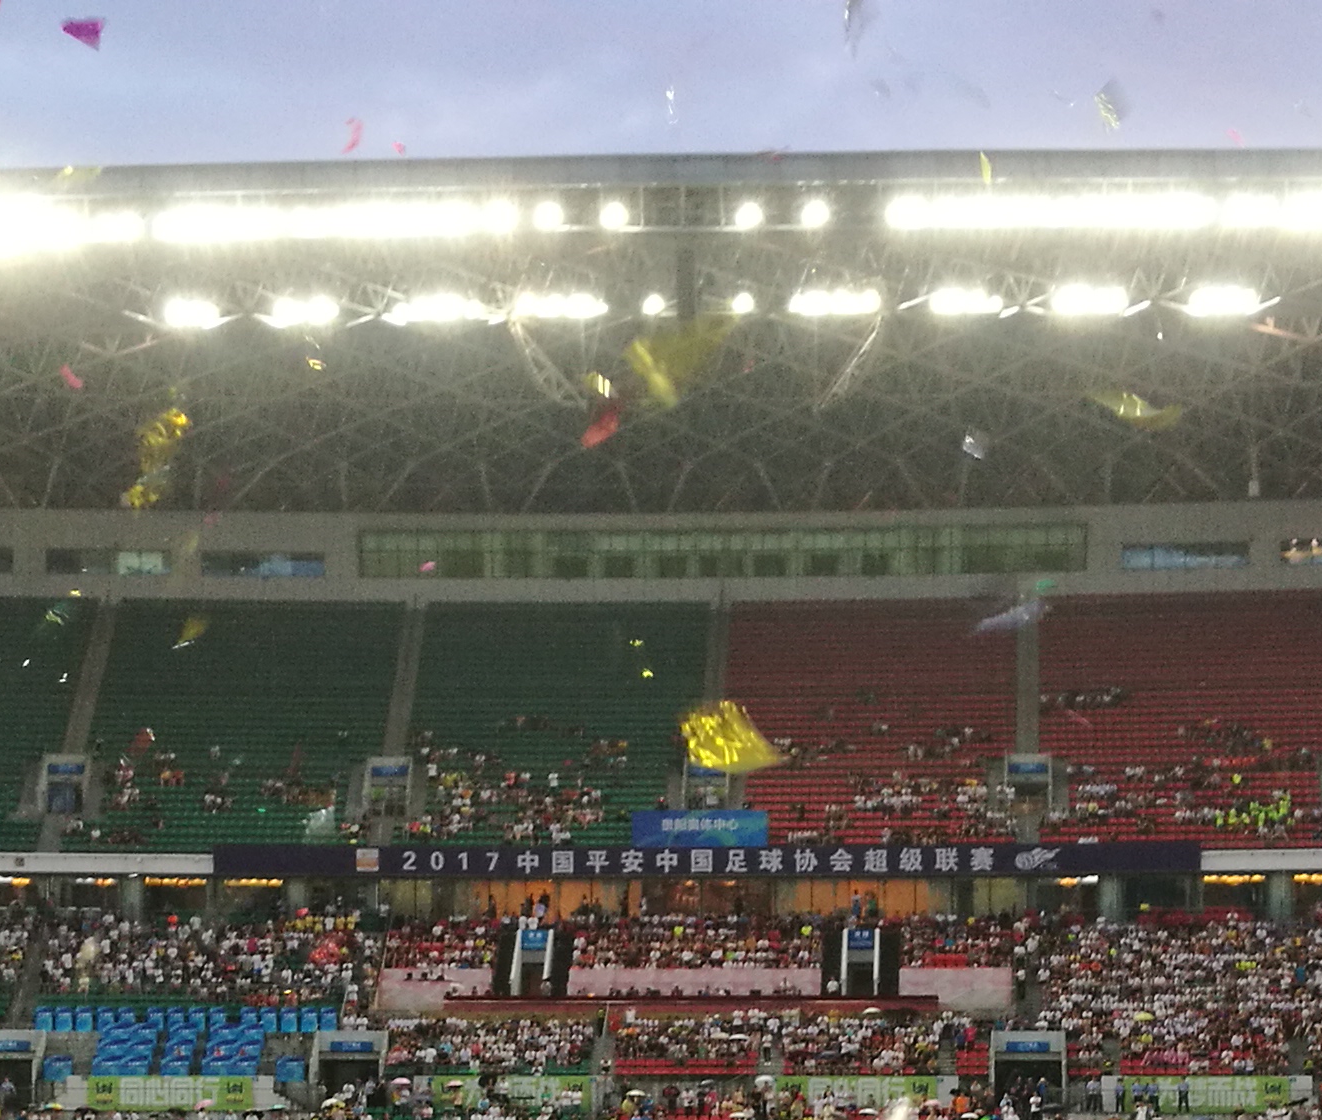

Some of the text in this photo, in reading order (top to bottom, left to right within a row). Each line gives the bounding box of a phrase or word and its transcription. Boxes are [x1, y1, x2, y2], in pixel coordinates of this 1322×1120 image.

[402, 849, 995, 874] 2017中国平安中国足球协会超级联赛
